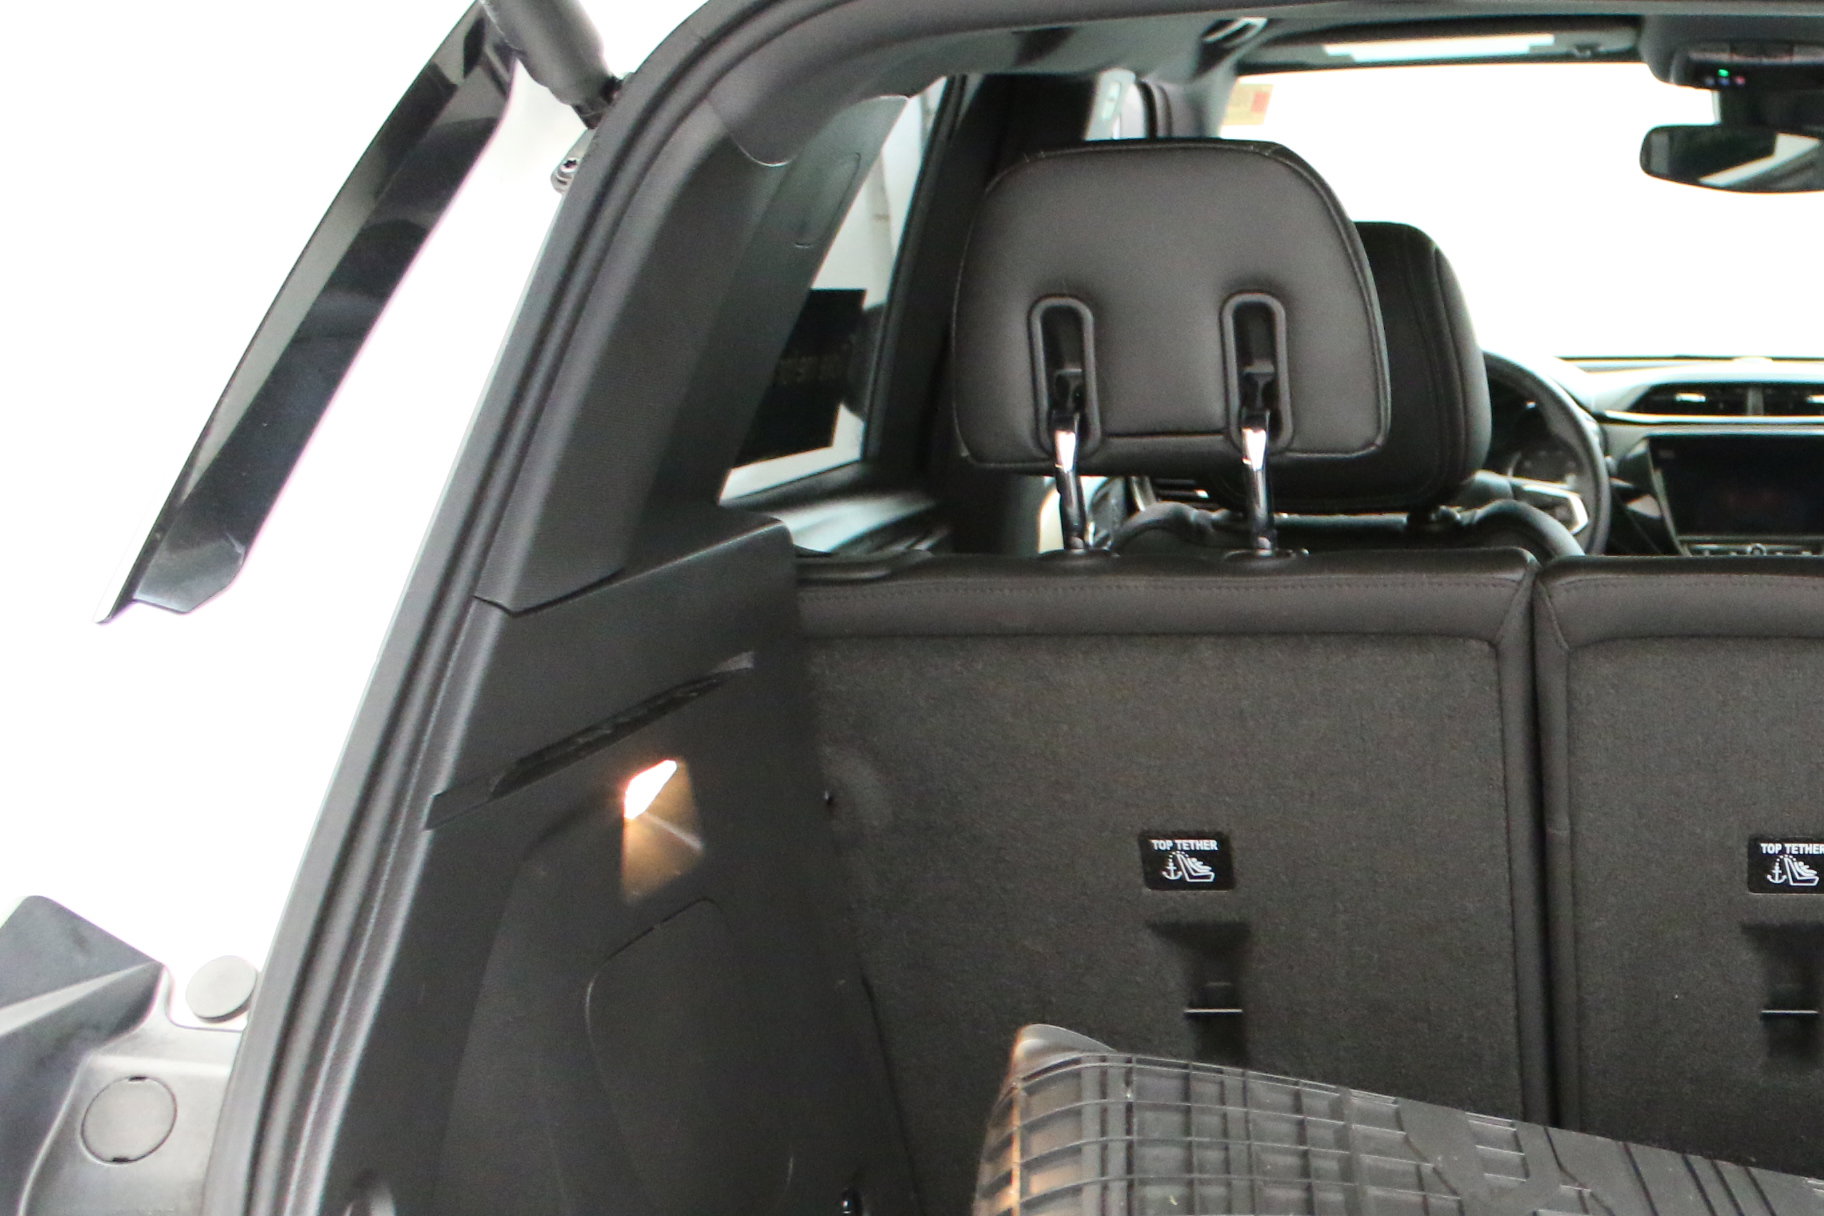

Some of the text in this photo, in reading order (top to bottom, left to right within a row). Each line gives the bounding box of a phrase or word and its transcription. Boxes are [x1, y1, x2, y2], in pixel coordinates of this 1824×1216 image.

[1151, 839, 1218, 850] TOP TETHER
[1760, 843, 1782, 854] TOP
